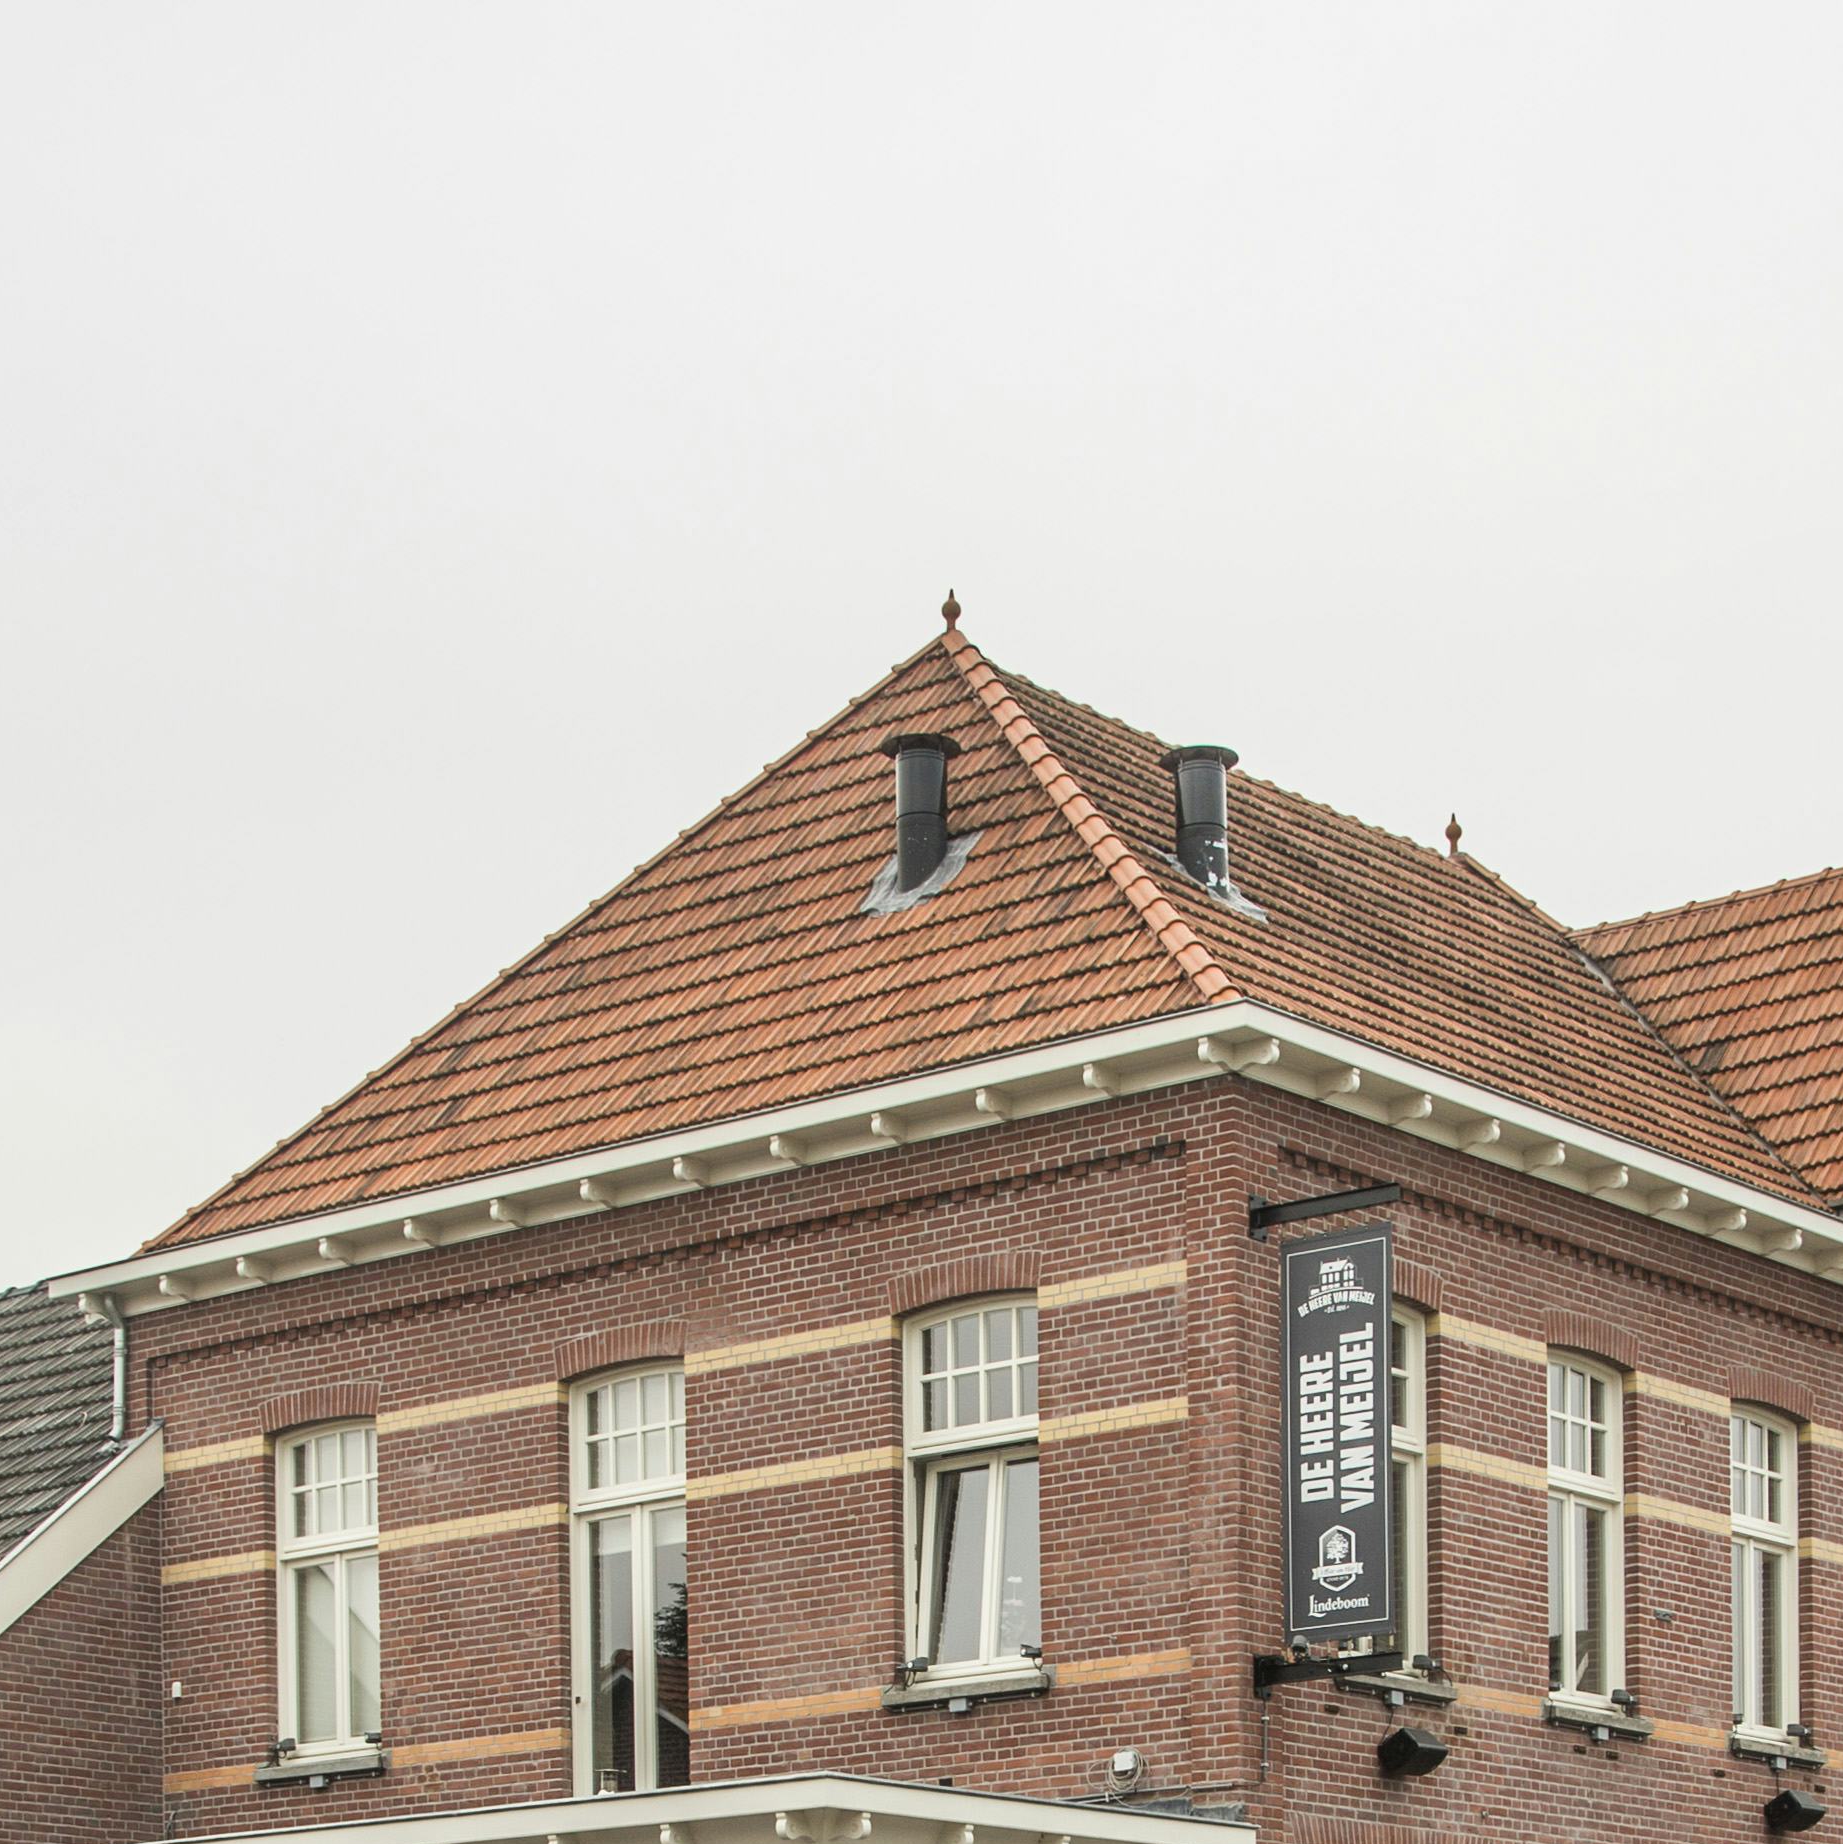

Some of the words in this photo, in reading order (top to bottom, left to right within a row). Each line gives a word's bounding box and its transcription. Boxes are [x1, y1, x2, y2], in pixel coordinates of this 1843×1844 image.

[1332, 1291, 1349, 1303] VAN
[1300, 1351, 1334, 1454] HEERE
[1339, 1321, 1374, 1441] MEIJEL
[1300, 1457, 1335, 1504] DE
[1340, 1445, 1374, 1514] VAN
[1308, 1594, 1370, 1618] Lindeboom
